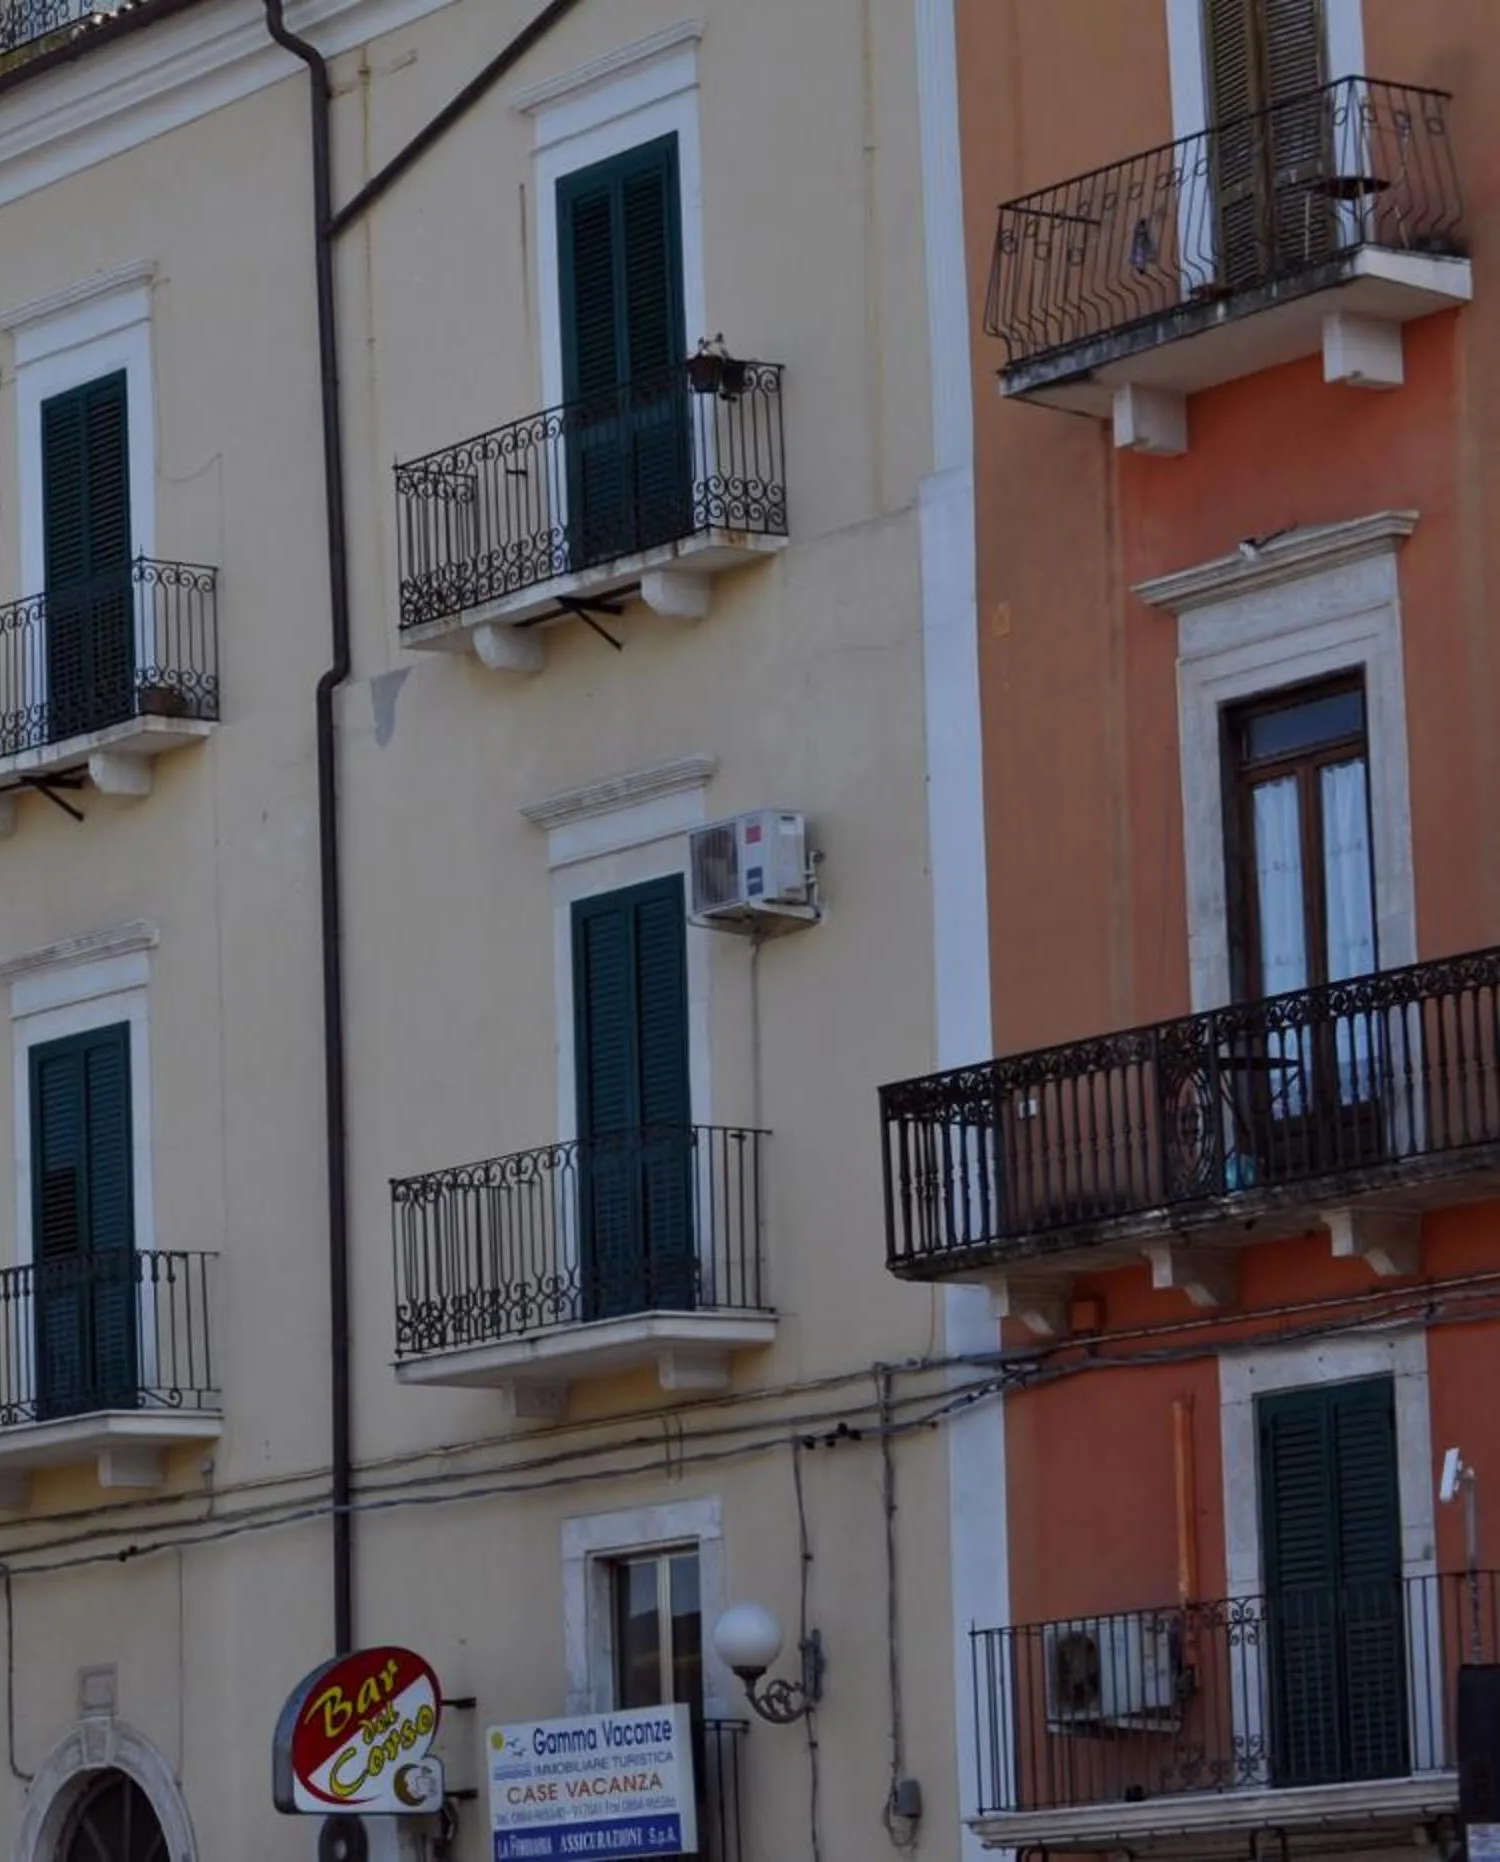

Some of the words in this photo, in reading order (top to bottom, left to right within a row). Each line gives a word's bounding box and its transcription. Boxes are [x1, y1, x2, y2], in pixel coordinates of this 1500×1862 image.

[303, 1658, 398, 1738] Bar
[329, 1704, 434, 1796] Corso
[533, 1727, 597, 1756] Gamma
[601, 1719, 673, 1748] Vacanze
[534, 1759, 609, 1776] IMMOBILIARE
[612, 1751, 673, 1768] TURISTICA
[507, 1783, 558, 1805] CASE
[565, 1772, 663, 1798] VACANZA
